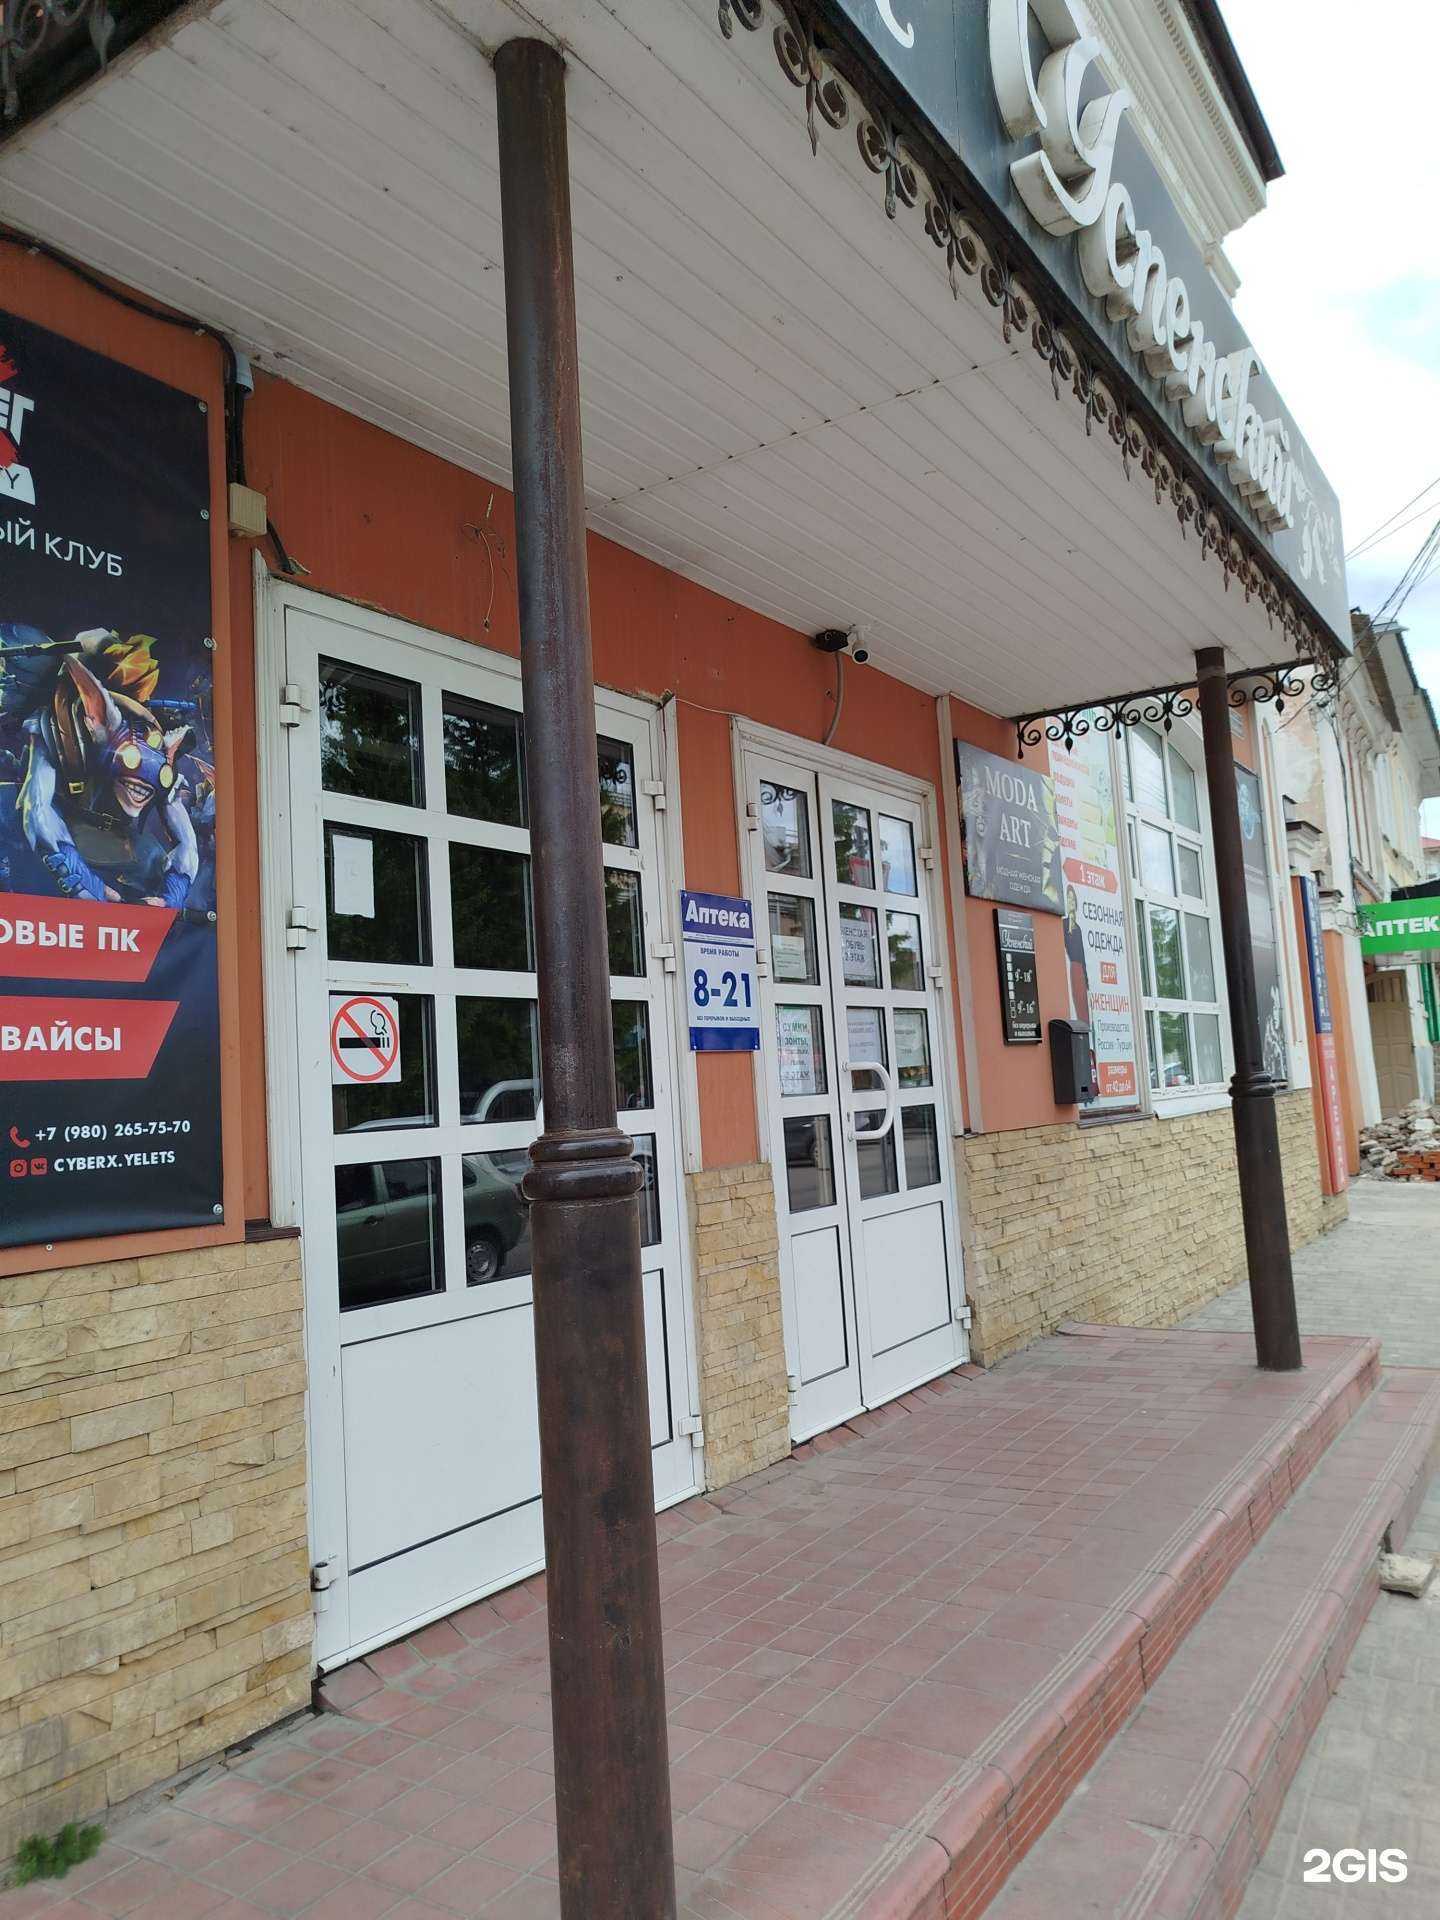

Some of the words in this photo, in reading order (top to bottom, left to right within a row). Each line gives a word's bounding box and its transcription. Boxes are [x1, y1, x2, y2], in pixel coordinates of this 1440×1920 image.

[45, 532, 123, 577] КЛУБ
[984, 765, 1039, 813] MODA
[1000, 813, 1032, 848] ART
[1080, 864, 1085, 882] 1
[685, 899, 750, 929] Аптека
[1082, 901, 1124, 927] СЕЗОННАЯ
[97, 926, 140, 953] ПК
[1087, 930, 1124, 956] ОДЕЖДА
[693, 968, 752, 1008] 8-21
[35, 1127, 57, 1141] +7
[64, 1124, 107, 1142] (980)
[114, 1120, 191, 1137] 265-75-70
